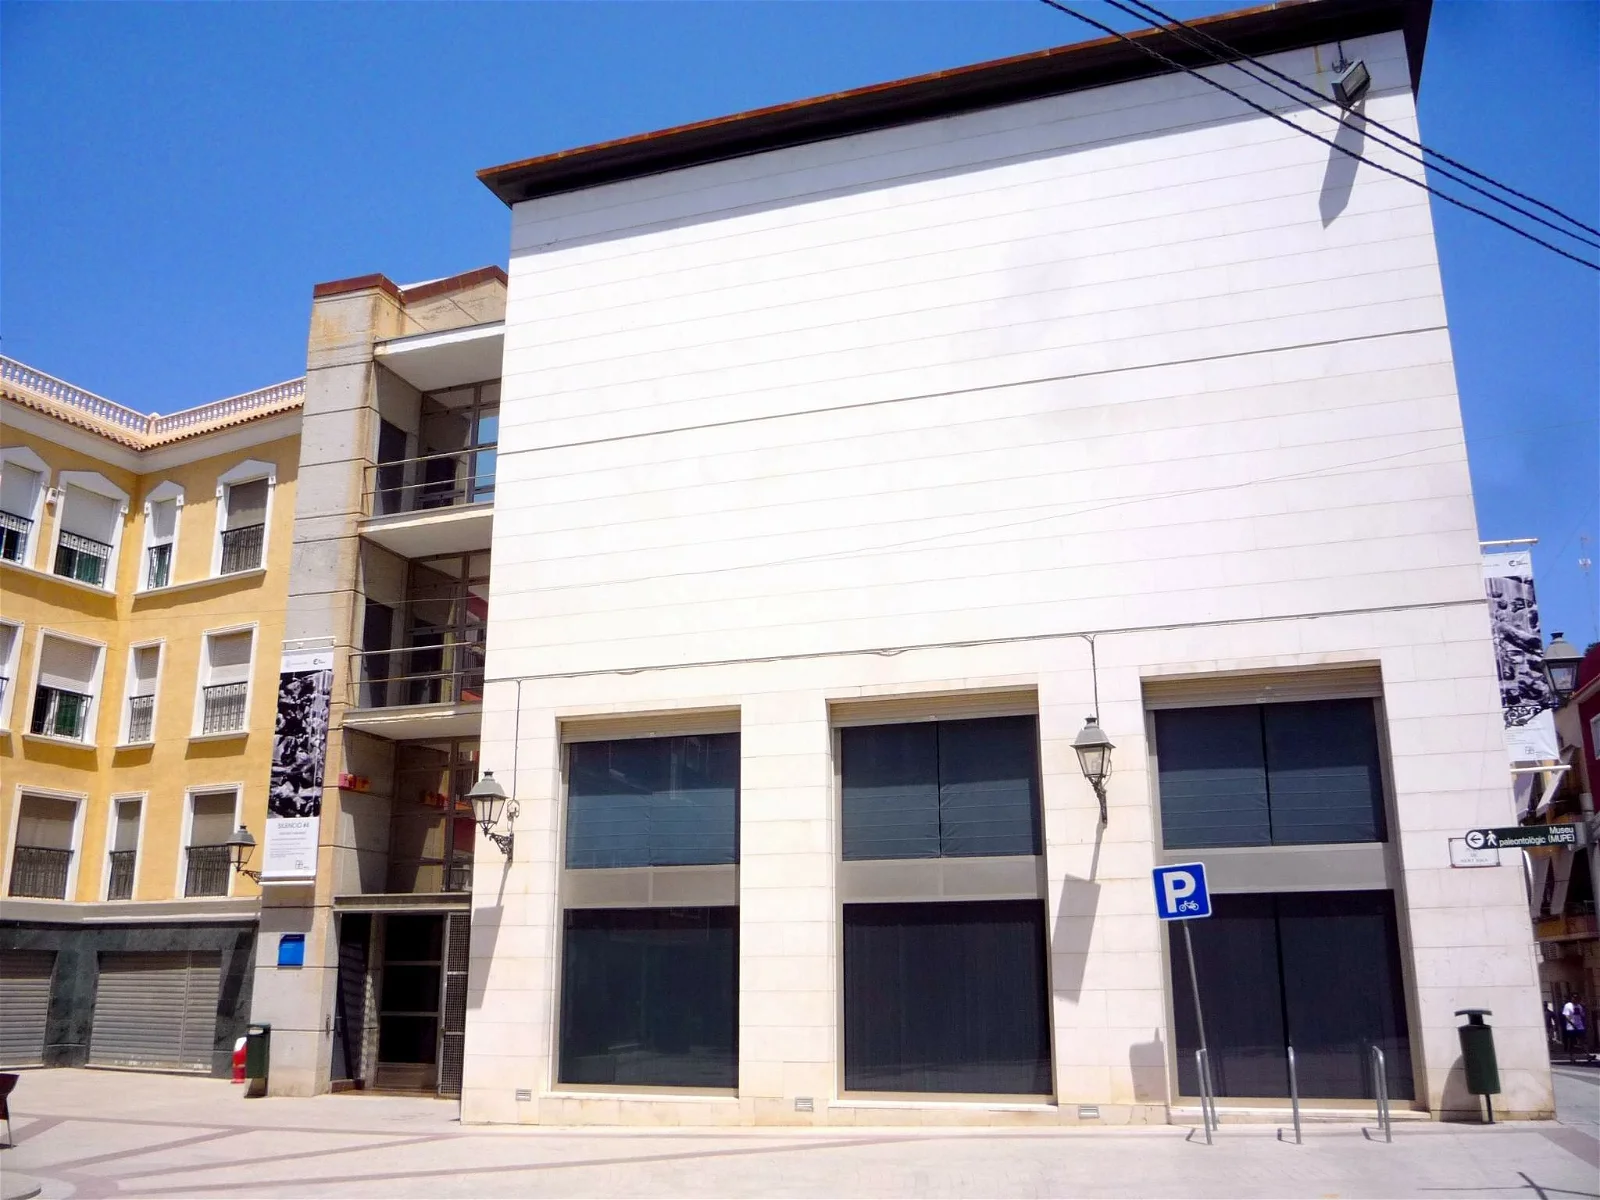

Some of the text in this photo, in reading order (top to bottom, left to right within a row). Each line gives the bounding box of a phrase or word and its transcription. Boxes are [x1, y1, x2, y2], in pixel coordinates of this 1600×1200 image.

[1549, 826, 1574, 834] Museu
[1548, 834, 1575, 843] (MUPE)
[1162, 870, 1196, 914] P
